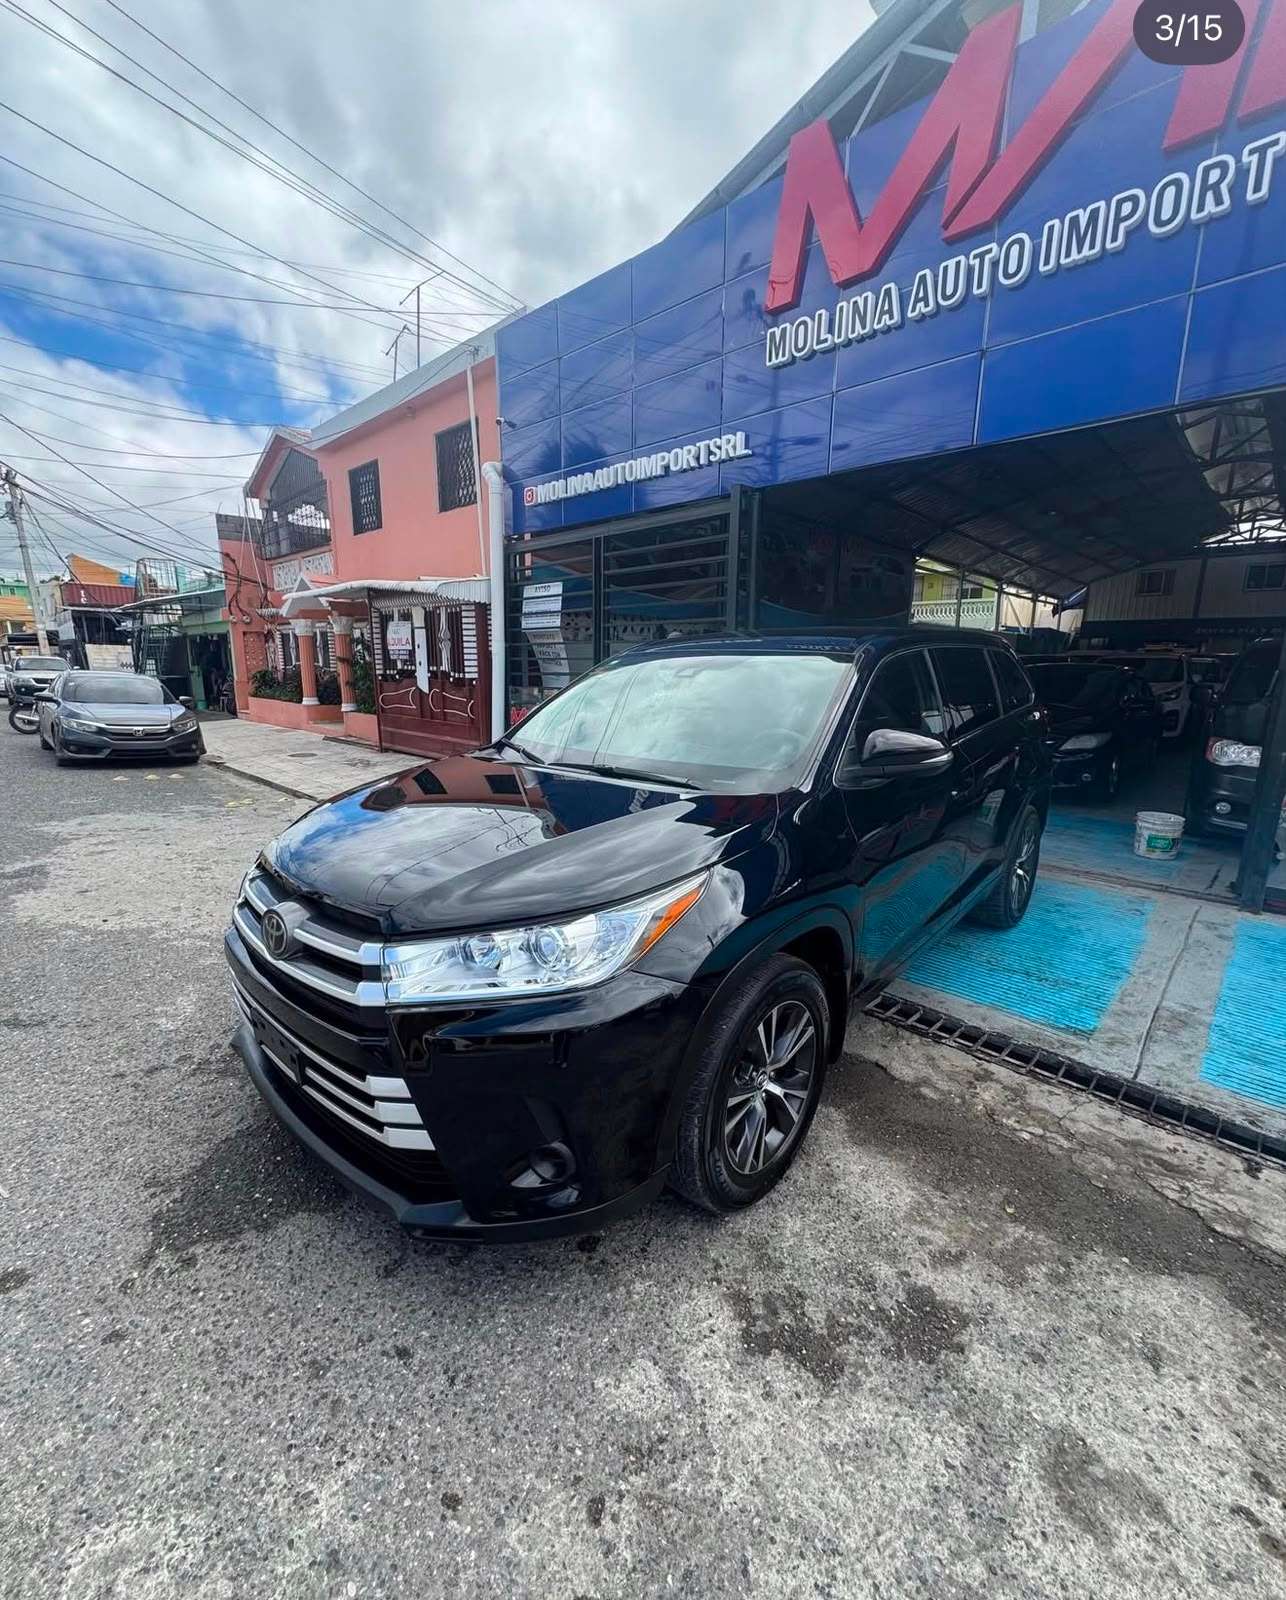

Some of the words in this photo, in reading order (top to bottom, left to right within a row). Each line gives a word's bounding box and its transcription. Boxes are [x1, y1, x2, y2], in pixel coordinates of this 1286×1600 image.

[765, 281, 901, 368] MOLINA
[907, 230, 1032, 320] AUTO
[1038, 130, 1286, 276] IMPORT
[537, 431, 753, 503] MOLINAAUTOIMPORTSRL
